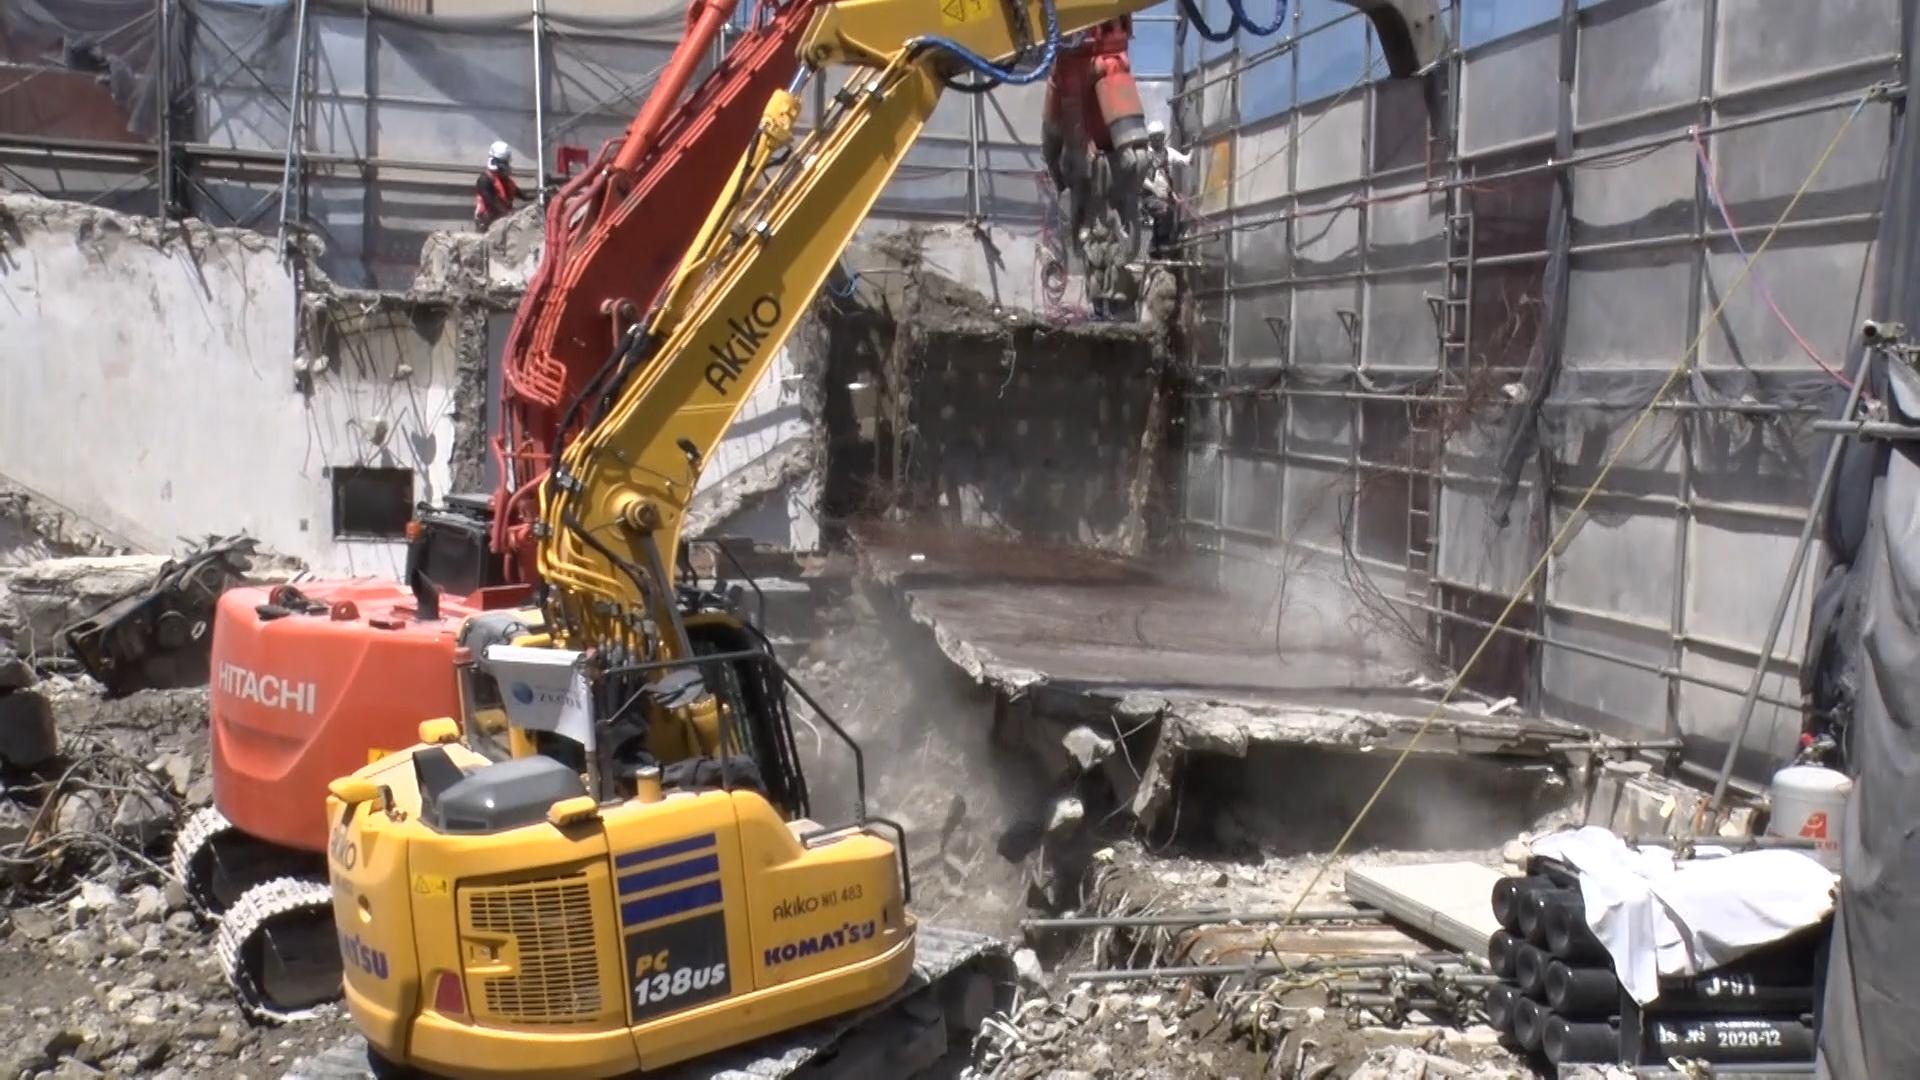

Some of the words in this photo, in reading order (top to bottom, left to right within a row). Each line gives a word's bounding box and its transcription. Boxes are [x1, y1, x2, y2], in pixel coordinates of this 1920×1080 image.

[218, 660, 316, 715] HITACHI
[841, 883, 863, 902] 483
[763, 919, 876, 966] KOMATSU
[635, 948, 669, 977] PC
